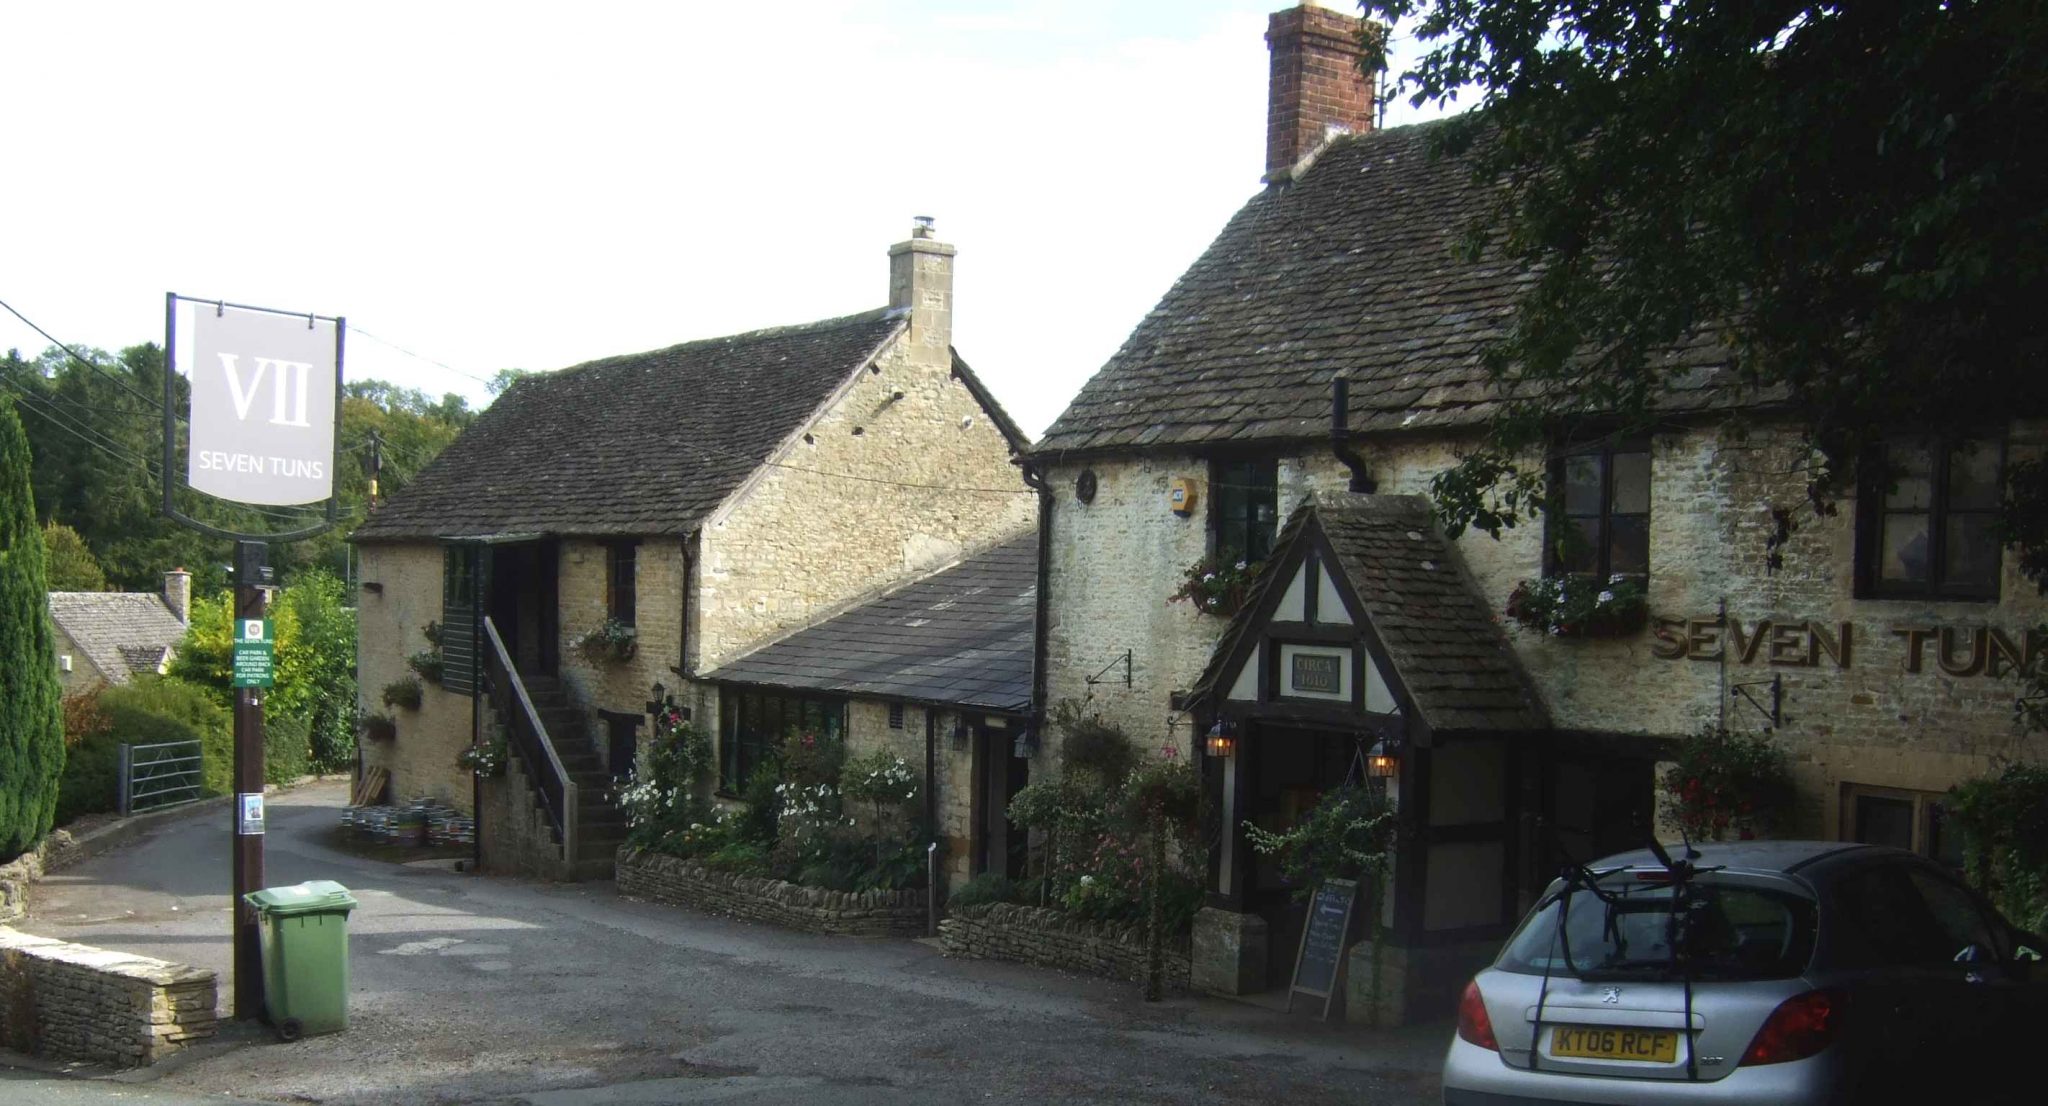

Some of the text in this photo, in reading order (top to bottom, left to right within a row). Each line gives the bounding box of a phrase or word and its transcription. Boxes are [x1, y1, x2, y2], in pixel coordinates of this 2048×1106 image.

[217, 352, 313, 427] VII
[199, 450, 323, 480] SEVEN TUNS
[1651, 615, 2048, 679] SEVEN TUN
[1296, 658, 1332, 672] CIRCA
[1559, 1030, 1667, 1056] KT06 RCF
